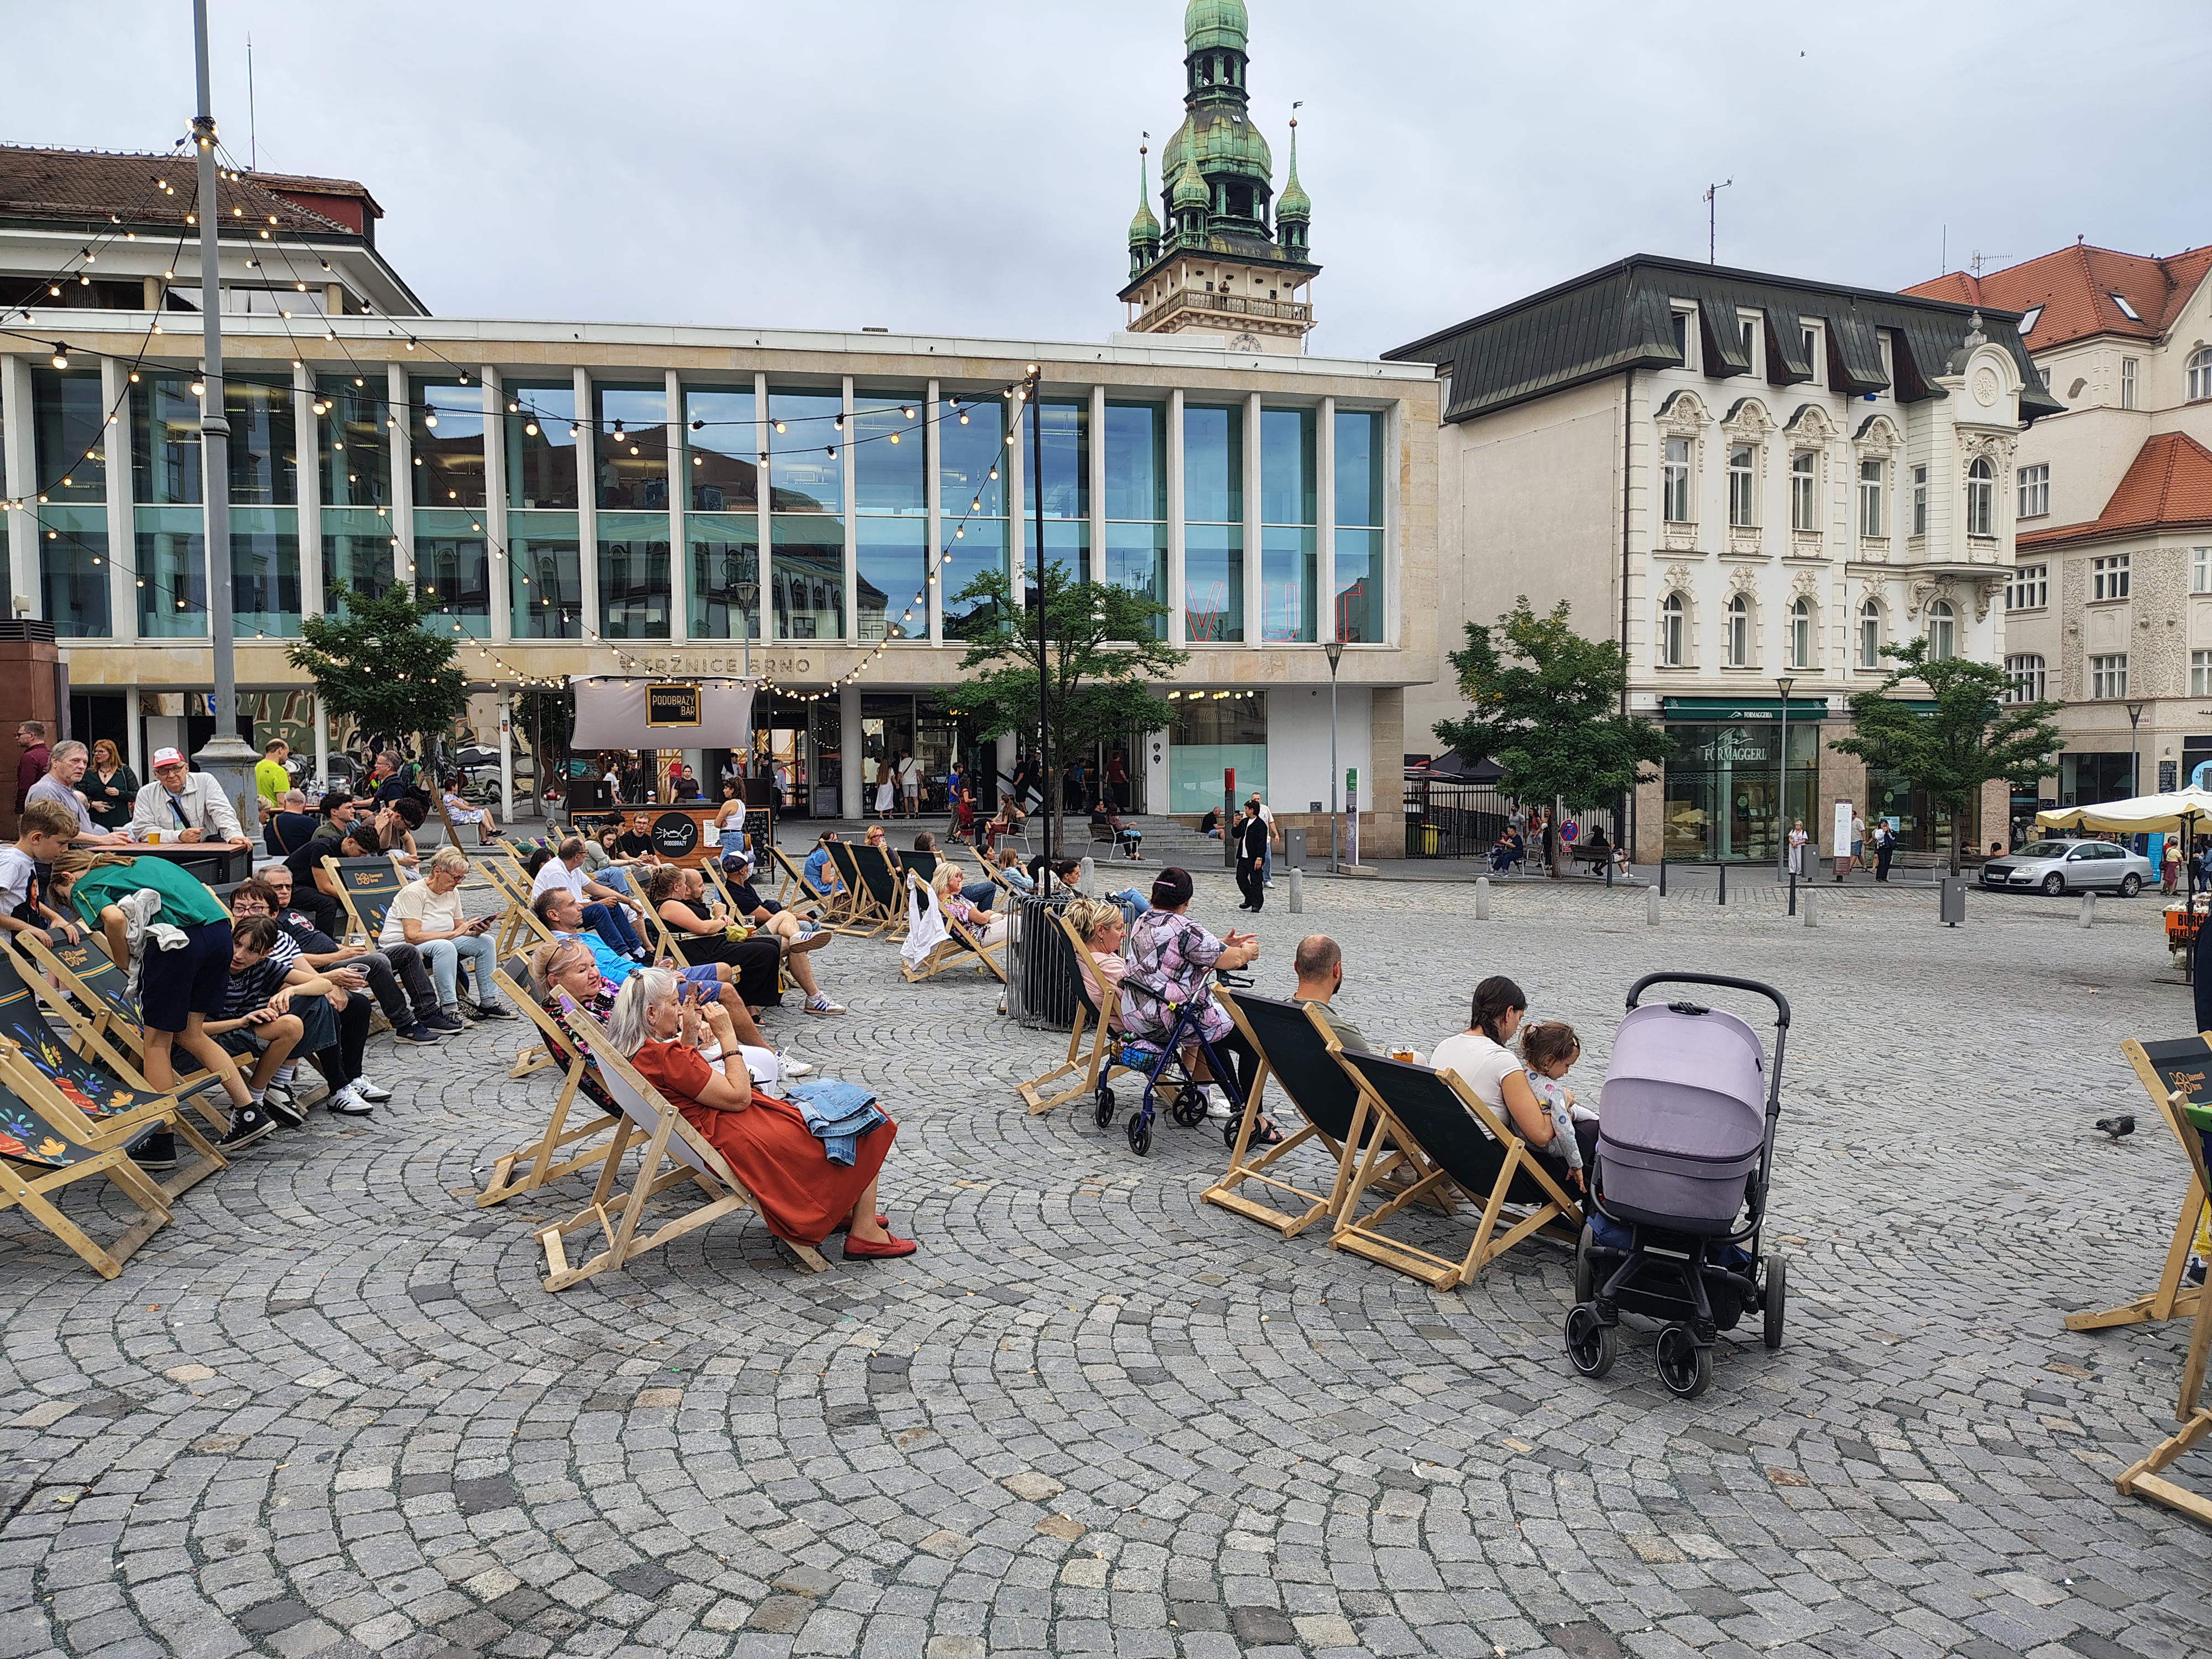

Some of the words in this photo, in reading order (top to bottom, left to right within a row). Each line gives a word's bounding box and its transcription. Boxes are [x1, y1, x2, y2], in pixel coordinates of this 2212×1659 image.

[641, 655, 737, 672] TRŽNICE
[749, 658, 810, 673] BRNO
[653, 695, 695, 706] PODOBRAZY
[681, 706, 695, 716] BAR
